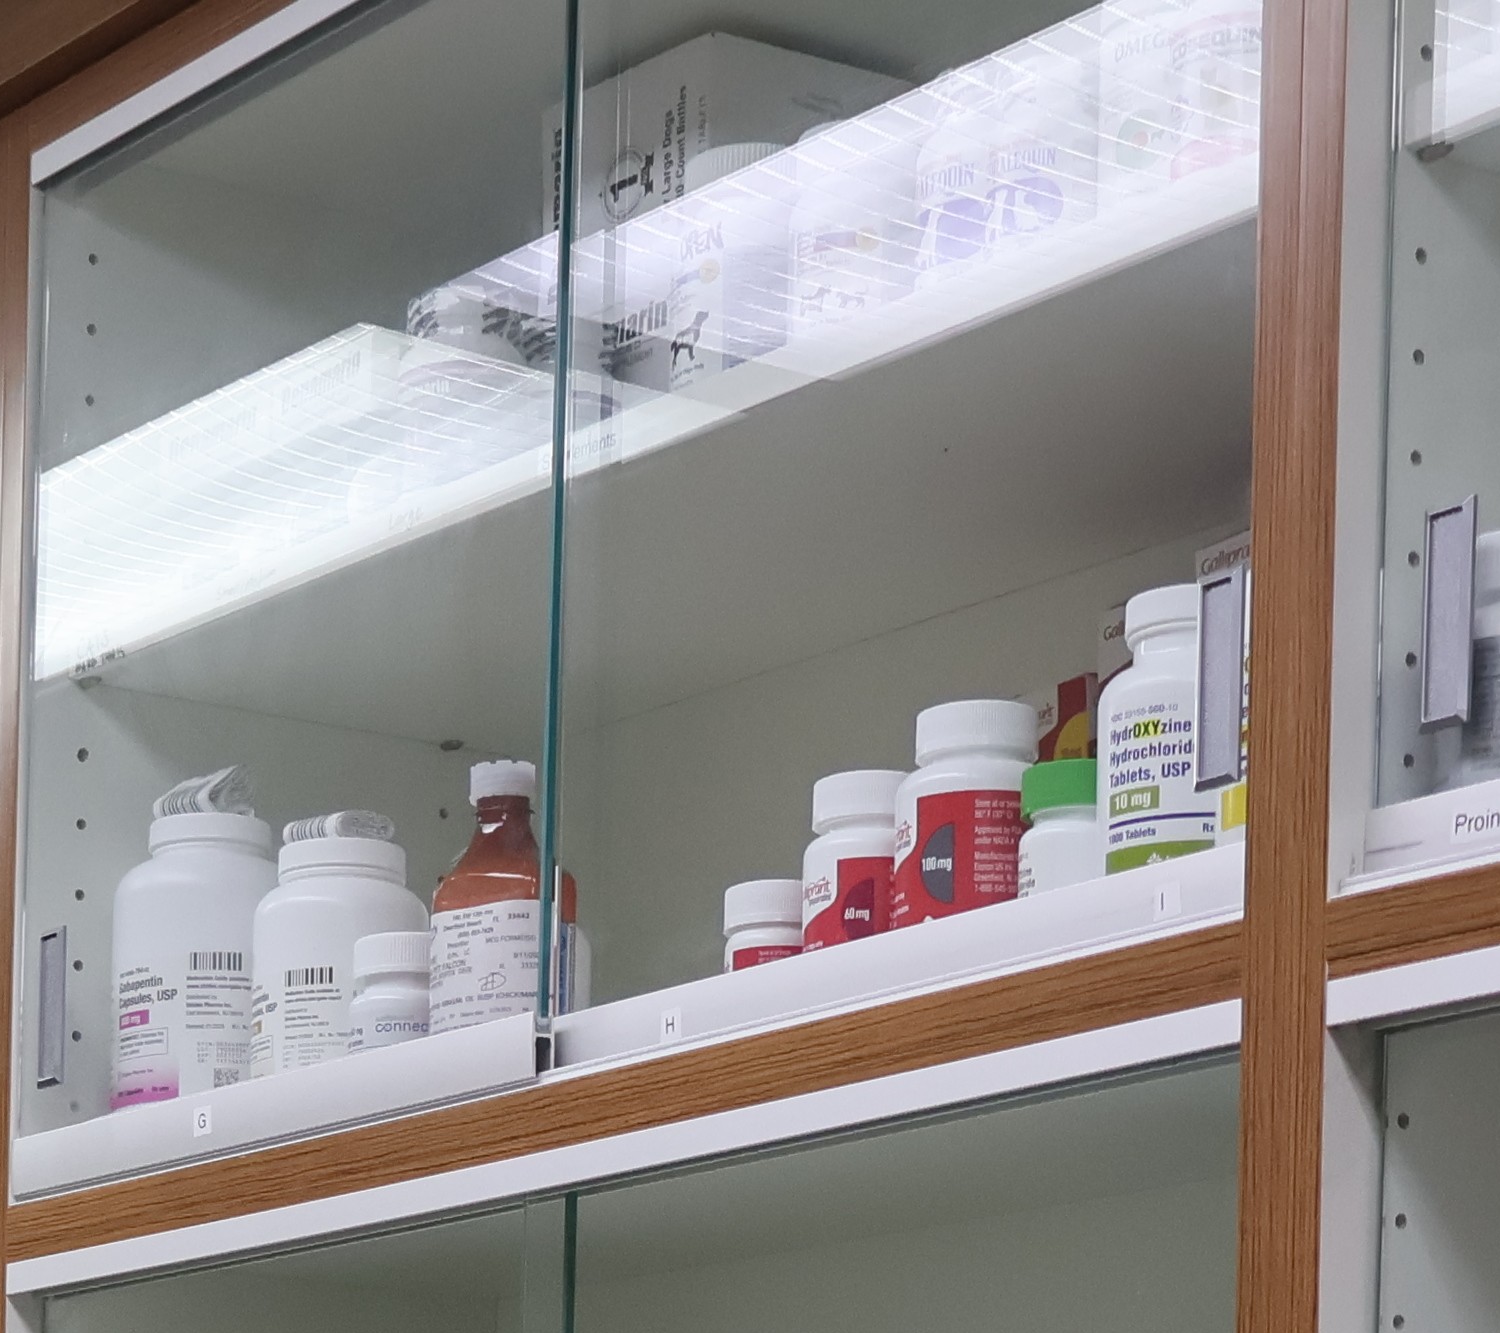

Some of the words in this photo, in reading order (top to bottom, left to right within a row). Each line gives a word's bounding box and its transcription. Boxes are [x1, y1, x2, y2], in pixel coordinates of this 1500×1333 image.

[662, 110, 674, 146] Dogs
[1109, 716, 1192, 746] HydrOXYzine
[1109, 739, 1194, 768] Hydrochlorid
[1109, 767, 1156, 789] Tablets,
[1161, 761, 1191, 779] USP
[1113, 792, 1127, 811] 10
[1130, 791, 1151, 808] mg
[1453, 807, 1500, 838] Proin
[1125, 826, 1157, 840] Tablets
[921, 856, 936, 871] 100
[936, 856, 953, 871] mg
[844, 907, 855, 920] 60
[855, 908, 871, 921] mg
[118, 974, 164, 995] Gabapentin
[156, 988, 178, 1002] USP
[664, 1016, 676, 1034] H
[197, 1112, 207, 1129] G
